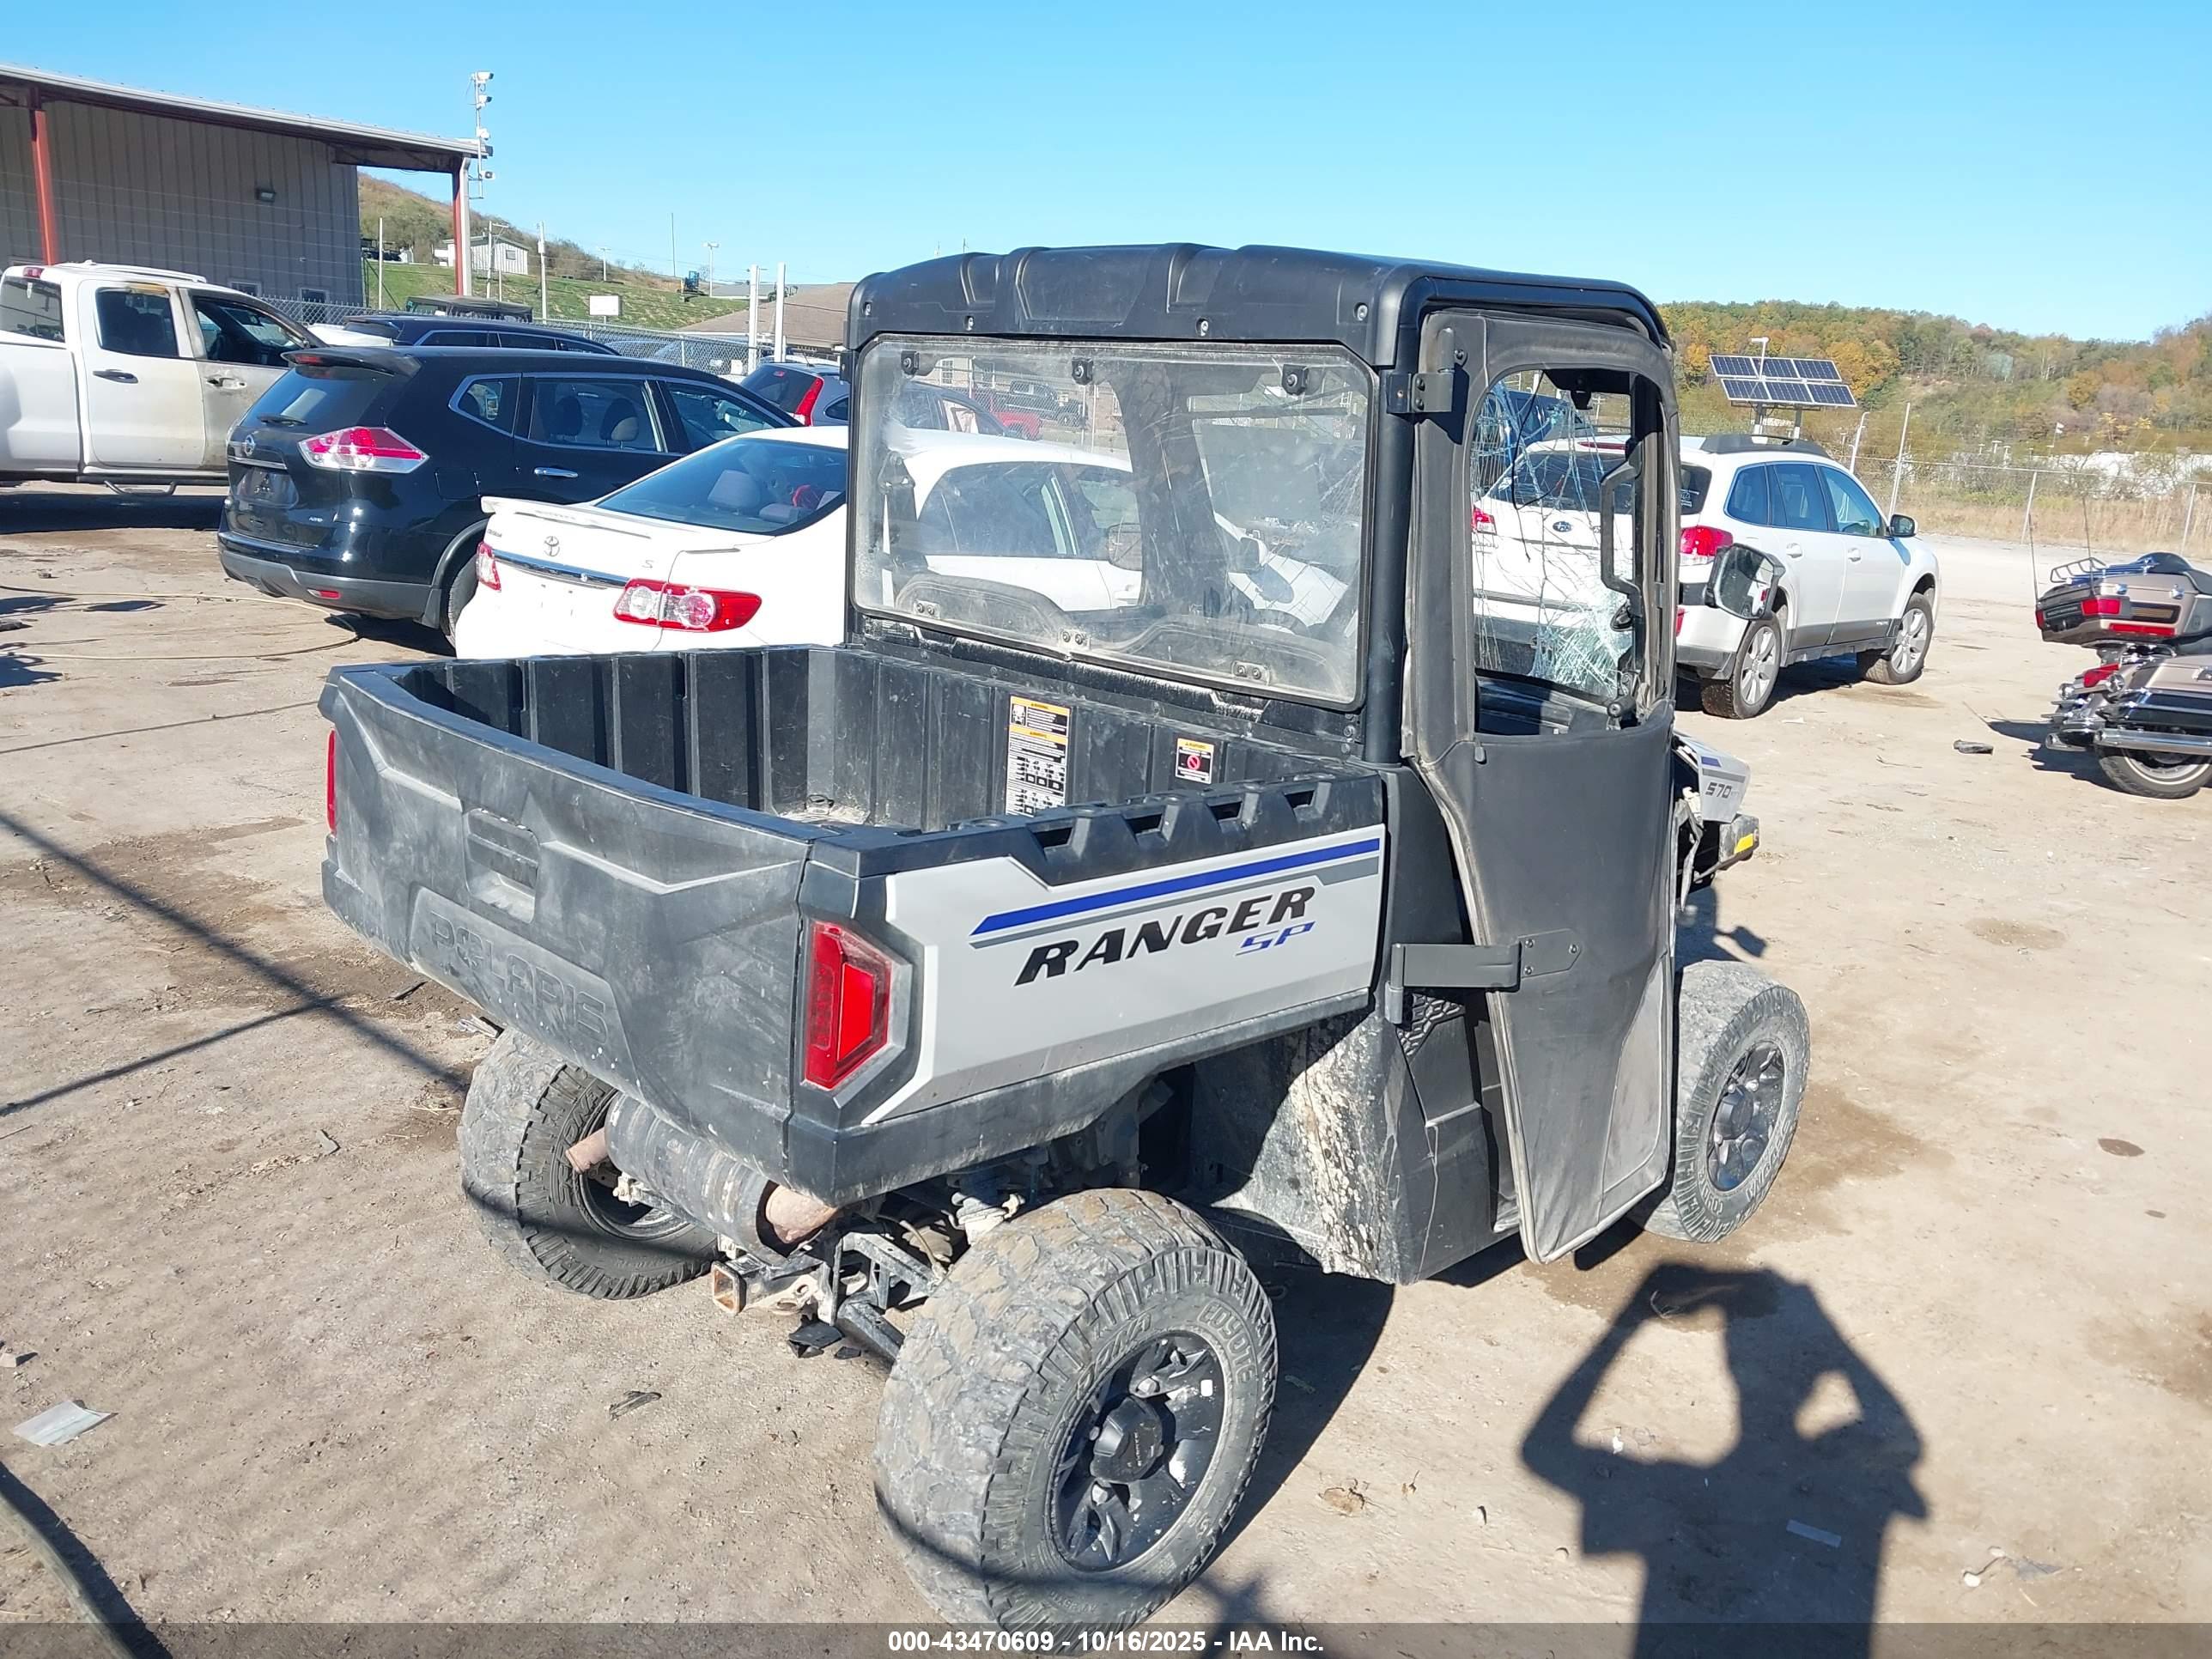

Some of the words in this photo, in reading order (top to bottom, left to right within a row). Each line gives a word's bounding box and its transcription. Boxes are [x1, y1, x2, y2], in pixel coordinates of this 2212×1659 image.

[1705, 781, 1732, 799] 570
[430, 909, 609, 1045] POLARIS
[1013, 886, 1316, 987] RANGER
[1234, 921, 1316, 956] SP
[1196, 1298, 1259, 1385] COYOTE
